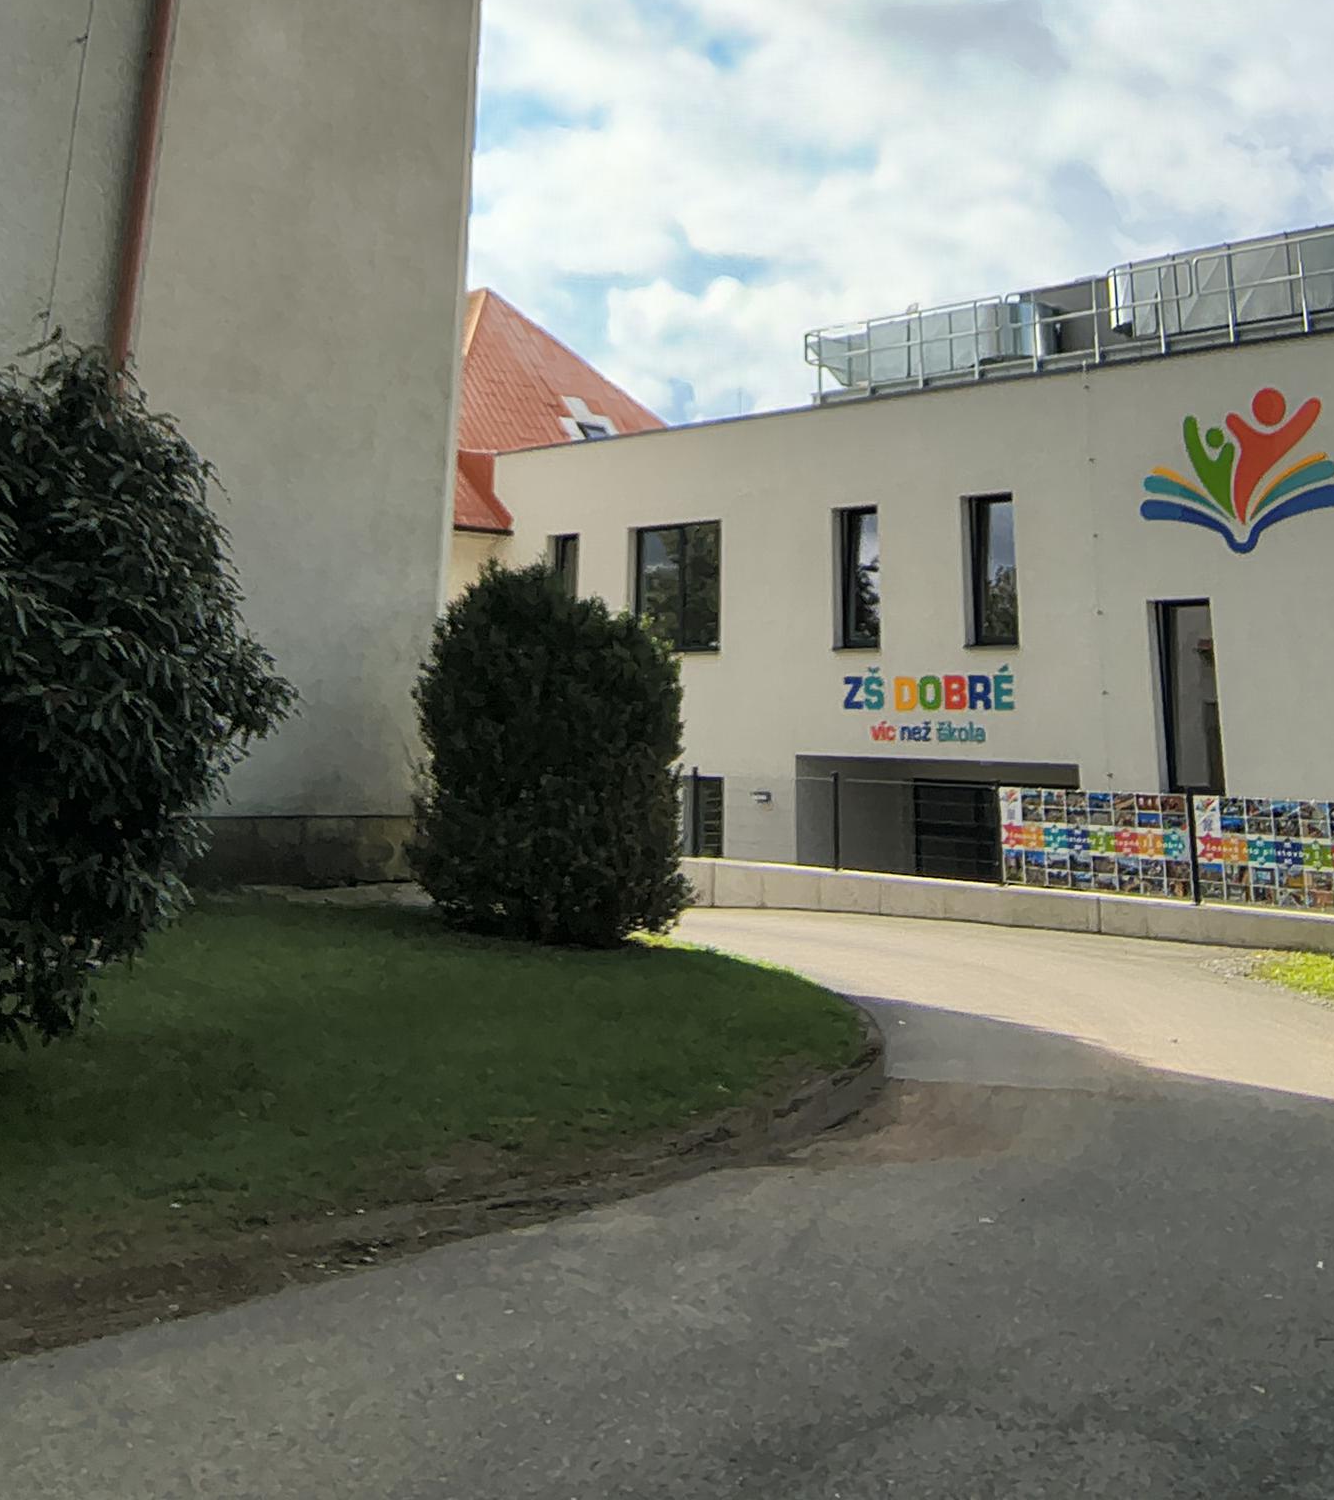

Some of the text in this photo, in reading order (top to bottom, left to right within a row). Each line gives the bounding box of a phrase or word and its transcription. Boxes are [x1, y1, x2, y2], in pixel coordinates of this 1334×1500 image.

[843, 663, 1015, 711] ZŠ DOBRÉ
[870, 721, 987, 743] víc než škola
